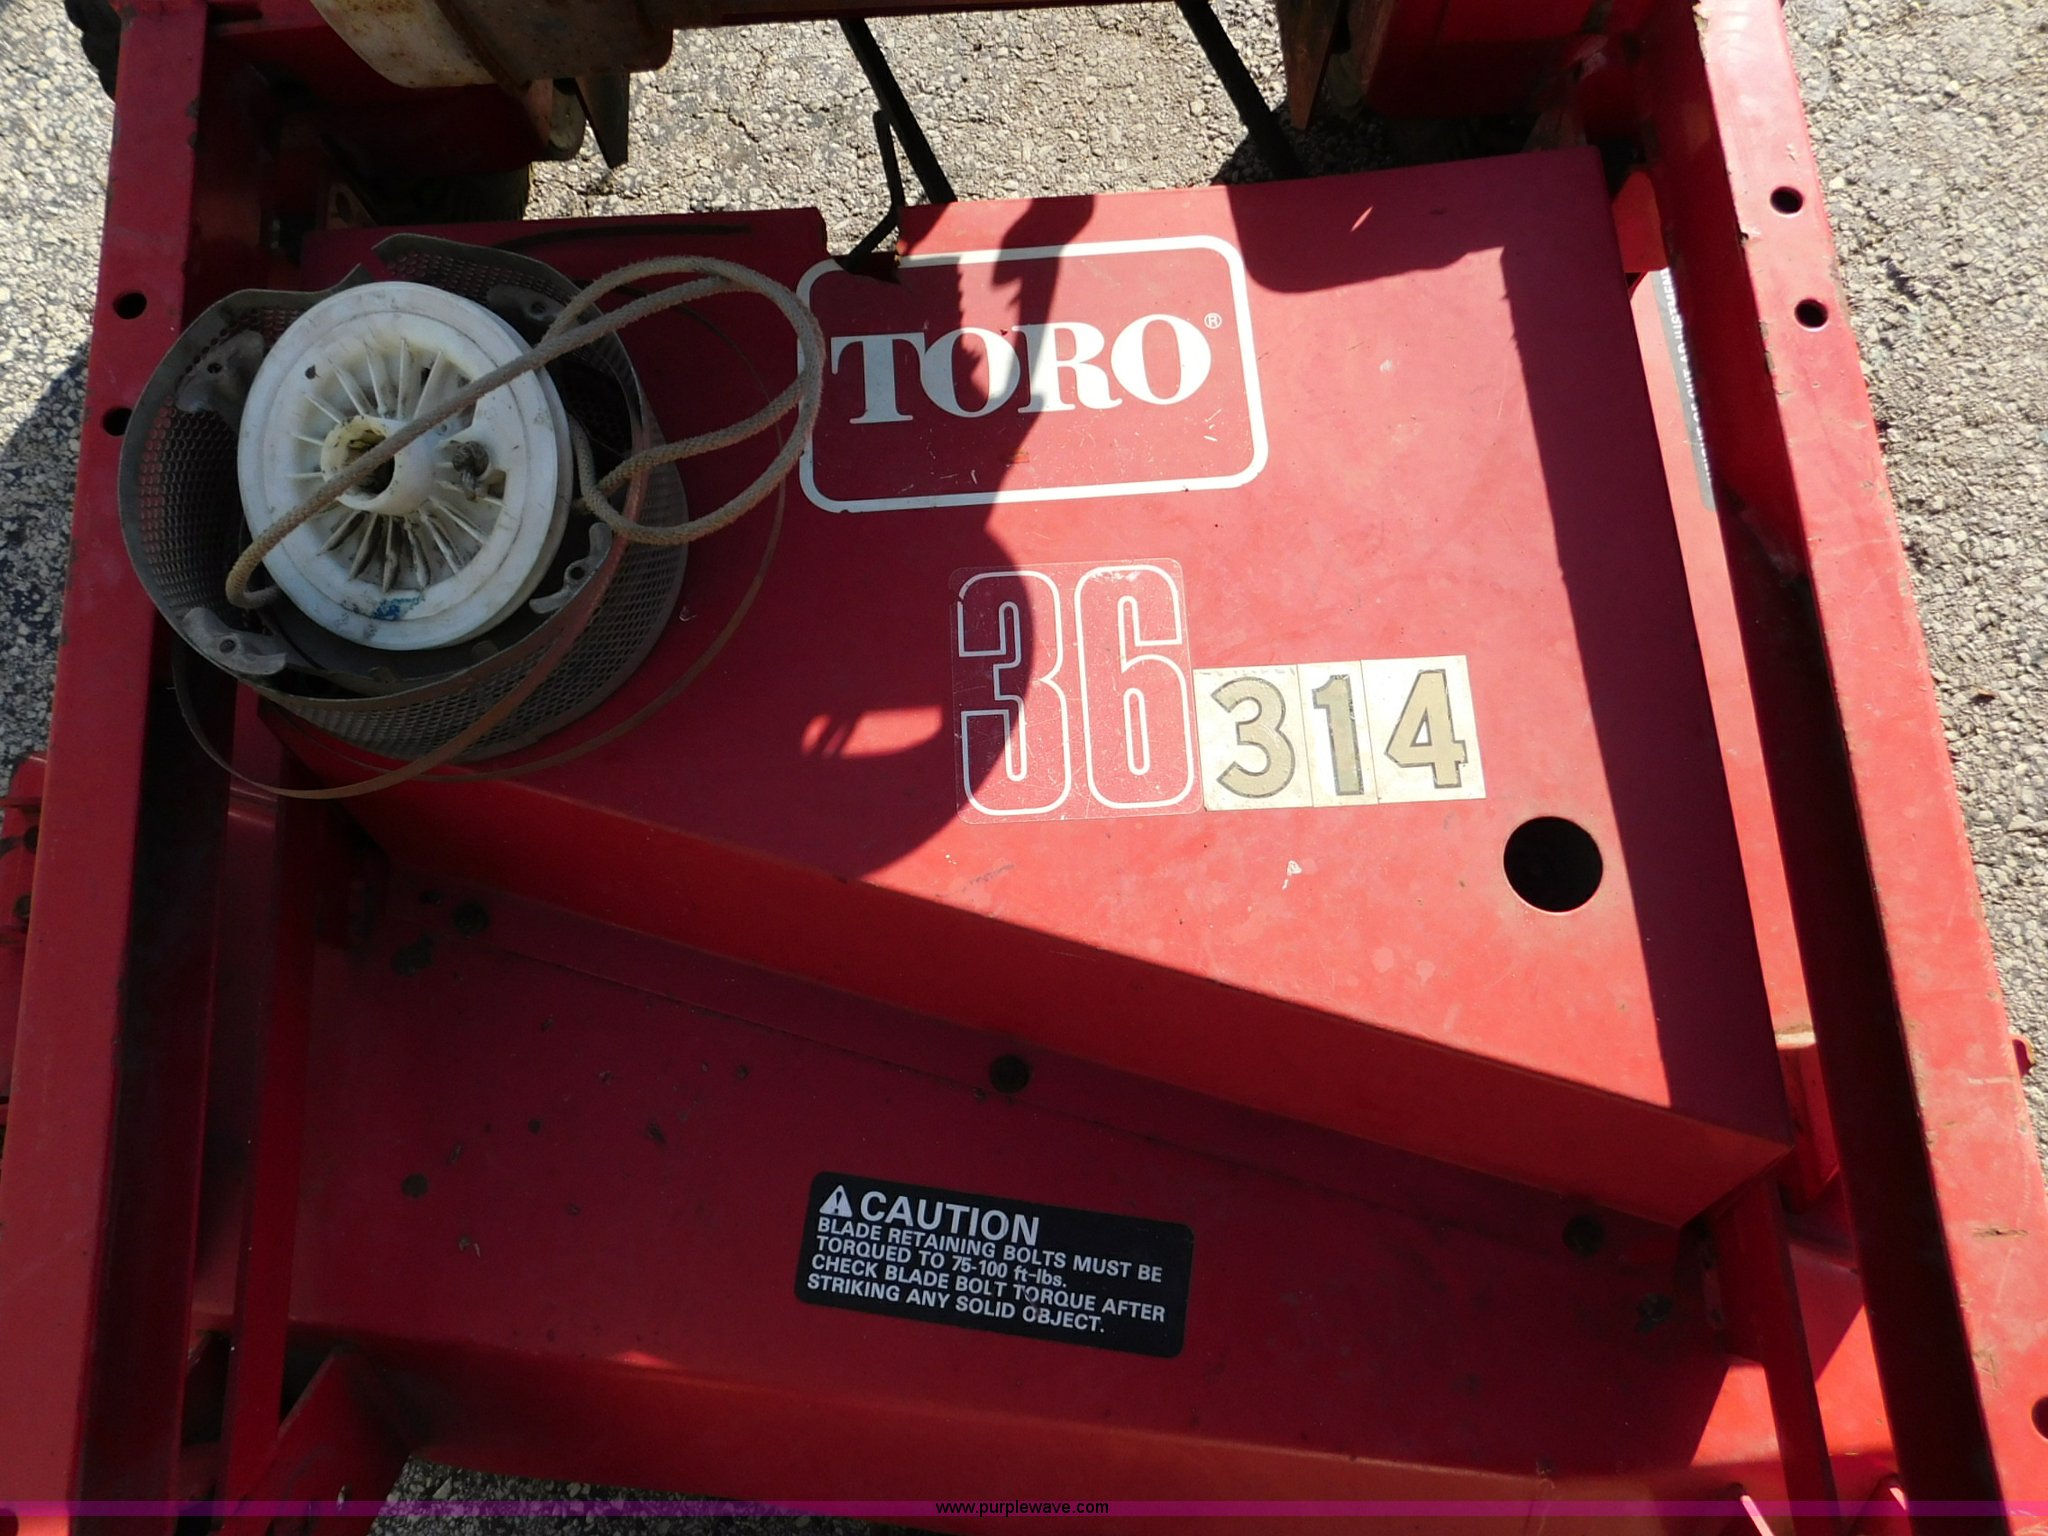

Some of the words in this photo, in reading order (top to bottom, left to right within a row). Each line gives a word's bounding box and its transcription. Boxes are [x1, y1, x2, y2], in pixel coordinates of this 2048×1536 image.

[831, 314, 1211, 424] TORO
[957, 564, 1194, 816] 36
[1210, 669, 1469, 799] 314
[818, 1217, 882, 1240] BLADE
[888, 1228, 996, 1258] RETAINING
[1003, 1245, 1066, 1269] BOLTS
[1073, 1255, 1132, 1278] MUST
[1137, 1264, 1163, 1283] BE
[861, 1191, 1040, 1246] CAUTION
[812, 1254, 878, 1278] CHECK
[885, 1265, 950, 1289] BLADE
[955, 1275, 1007, 1297] BOLT
[1013, 1284, 1096, 1311] TORQUE
[1102, 1298, 1166, 1322] AFTER
[817, 1235, 911, 1263] TORQUED
[919, 1250, 945, 1268] TO
[952, 1256, 1008, 1278] 75-100
[1014, 1266, 1067, 1288] ft-lbs.
[807, 1273, 900, 1302] STRIKING
[906, 1289, 950, 1308] ANY
[956, 1295, 1015, 1319] SOLID
[1022, 1305, 1105, 1333] OBJECT.
